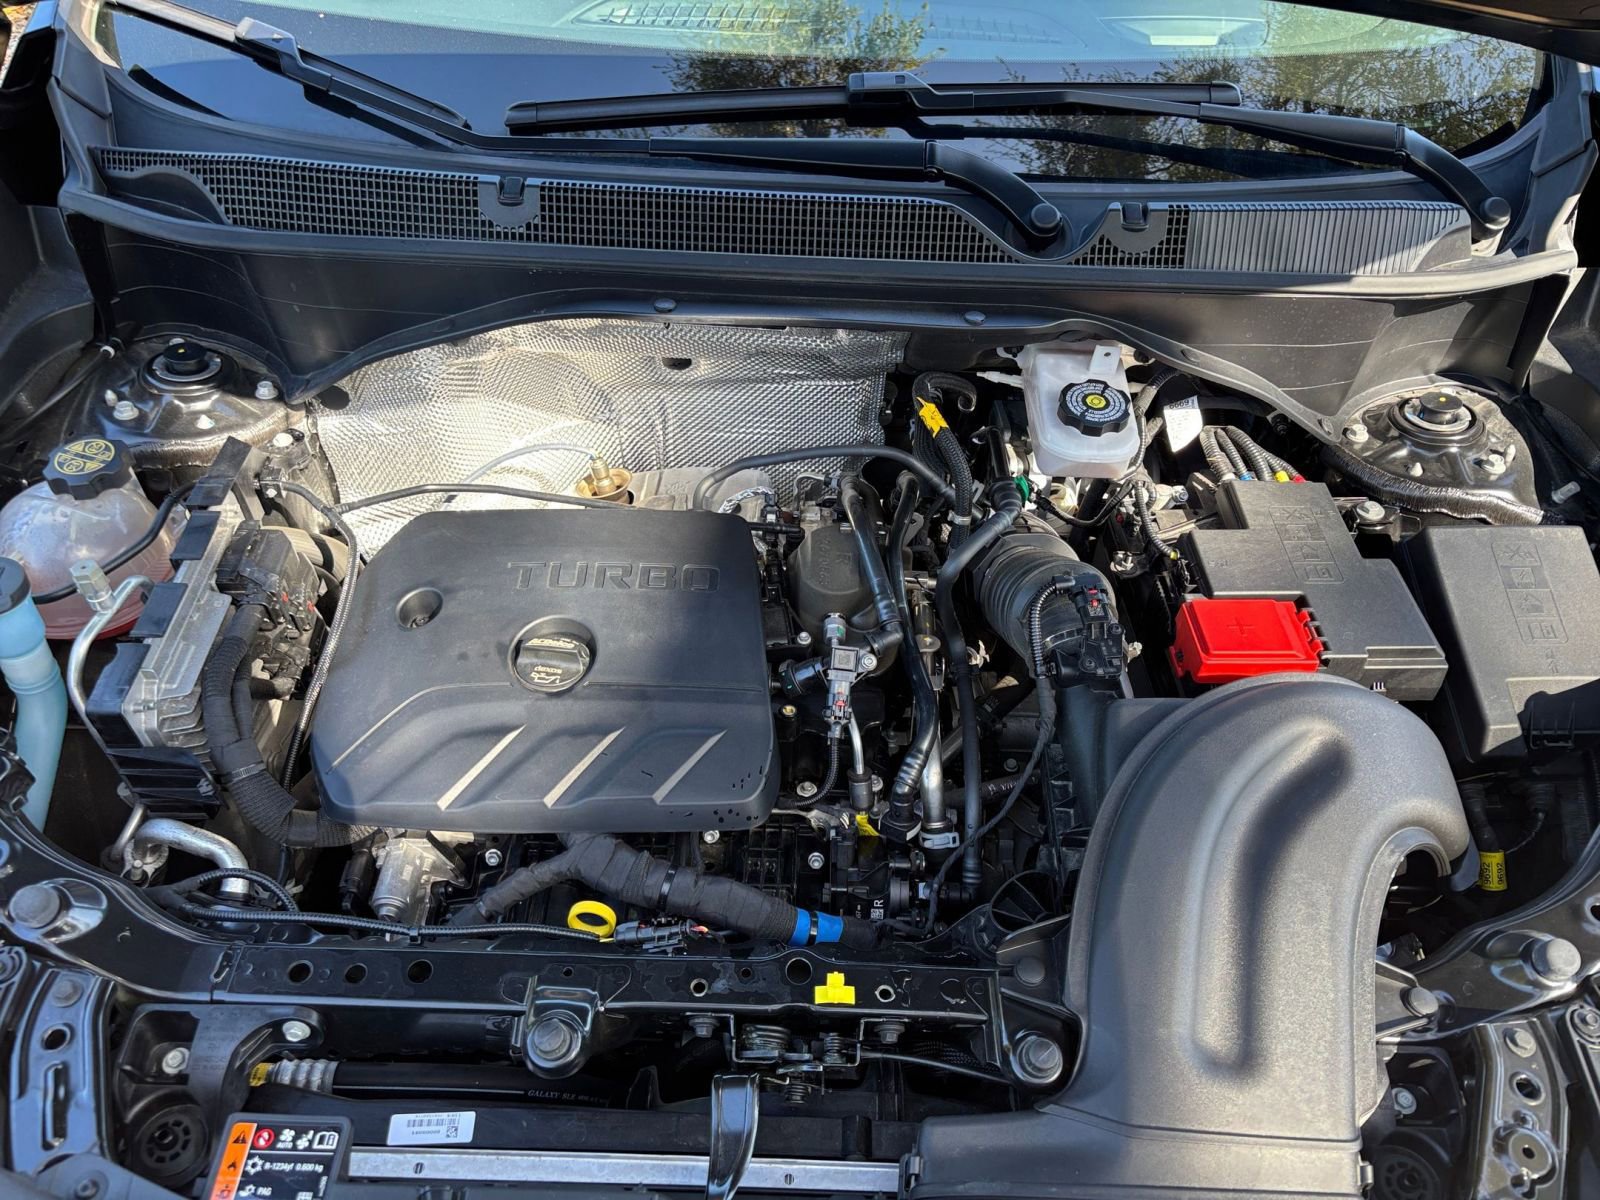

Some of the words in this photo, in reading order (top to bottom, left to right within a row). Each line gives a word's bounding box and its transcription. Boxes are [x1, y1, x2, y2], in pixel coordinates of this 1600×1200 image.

[507, 561, 721, 592] TURBO
[873, 899, 884, 907] R
[276, 1141, 293, 1149] AUTO
[314, 1163, 324, 1174] kg
[256, 1186, 273, 1197] PAG
